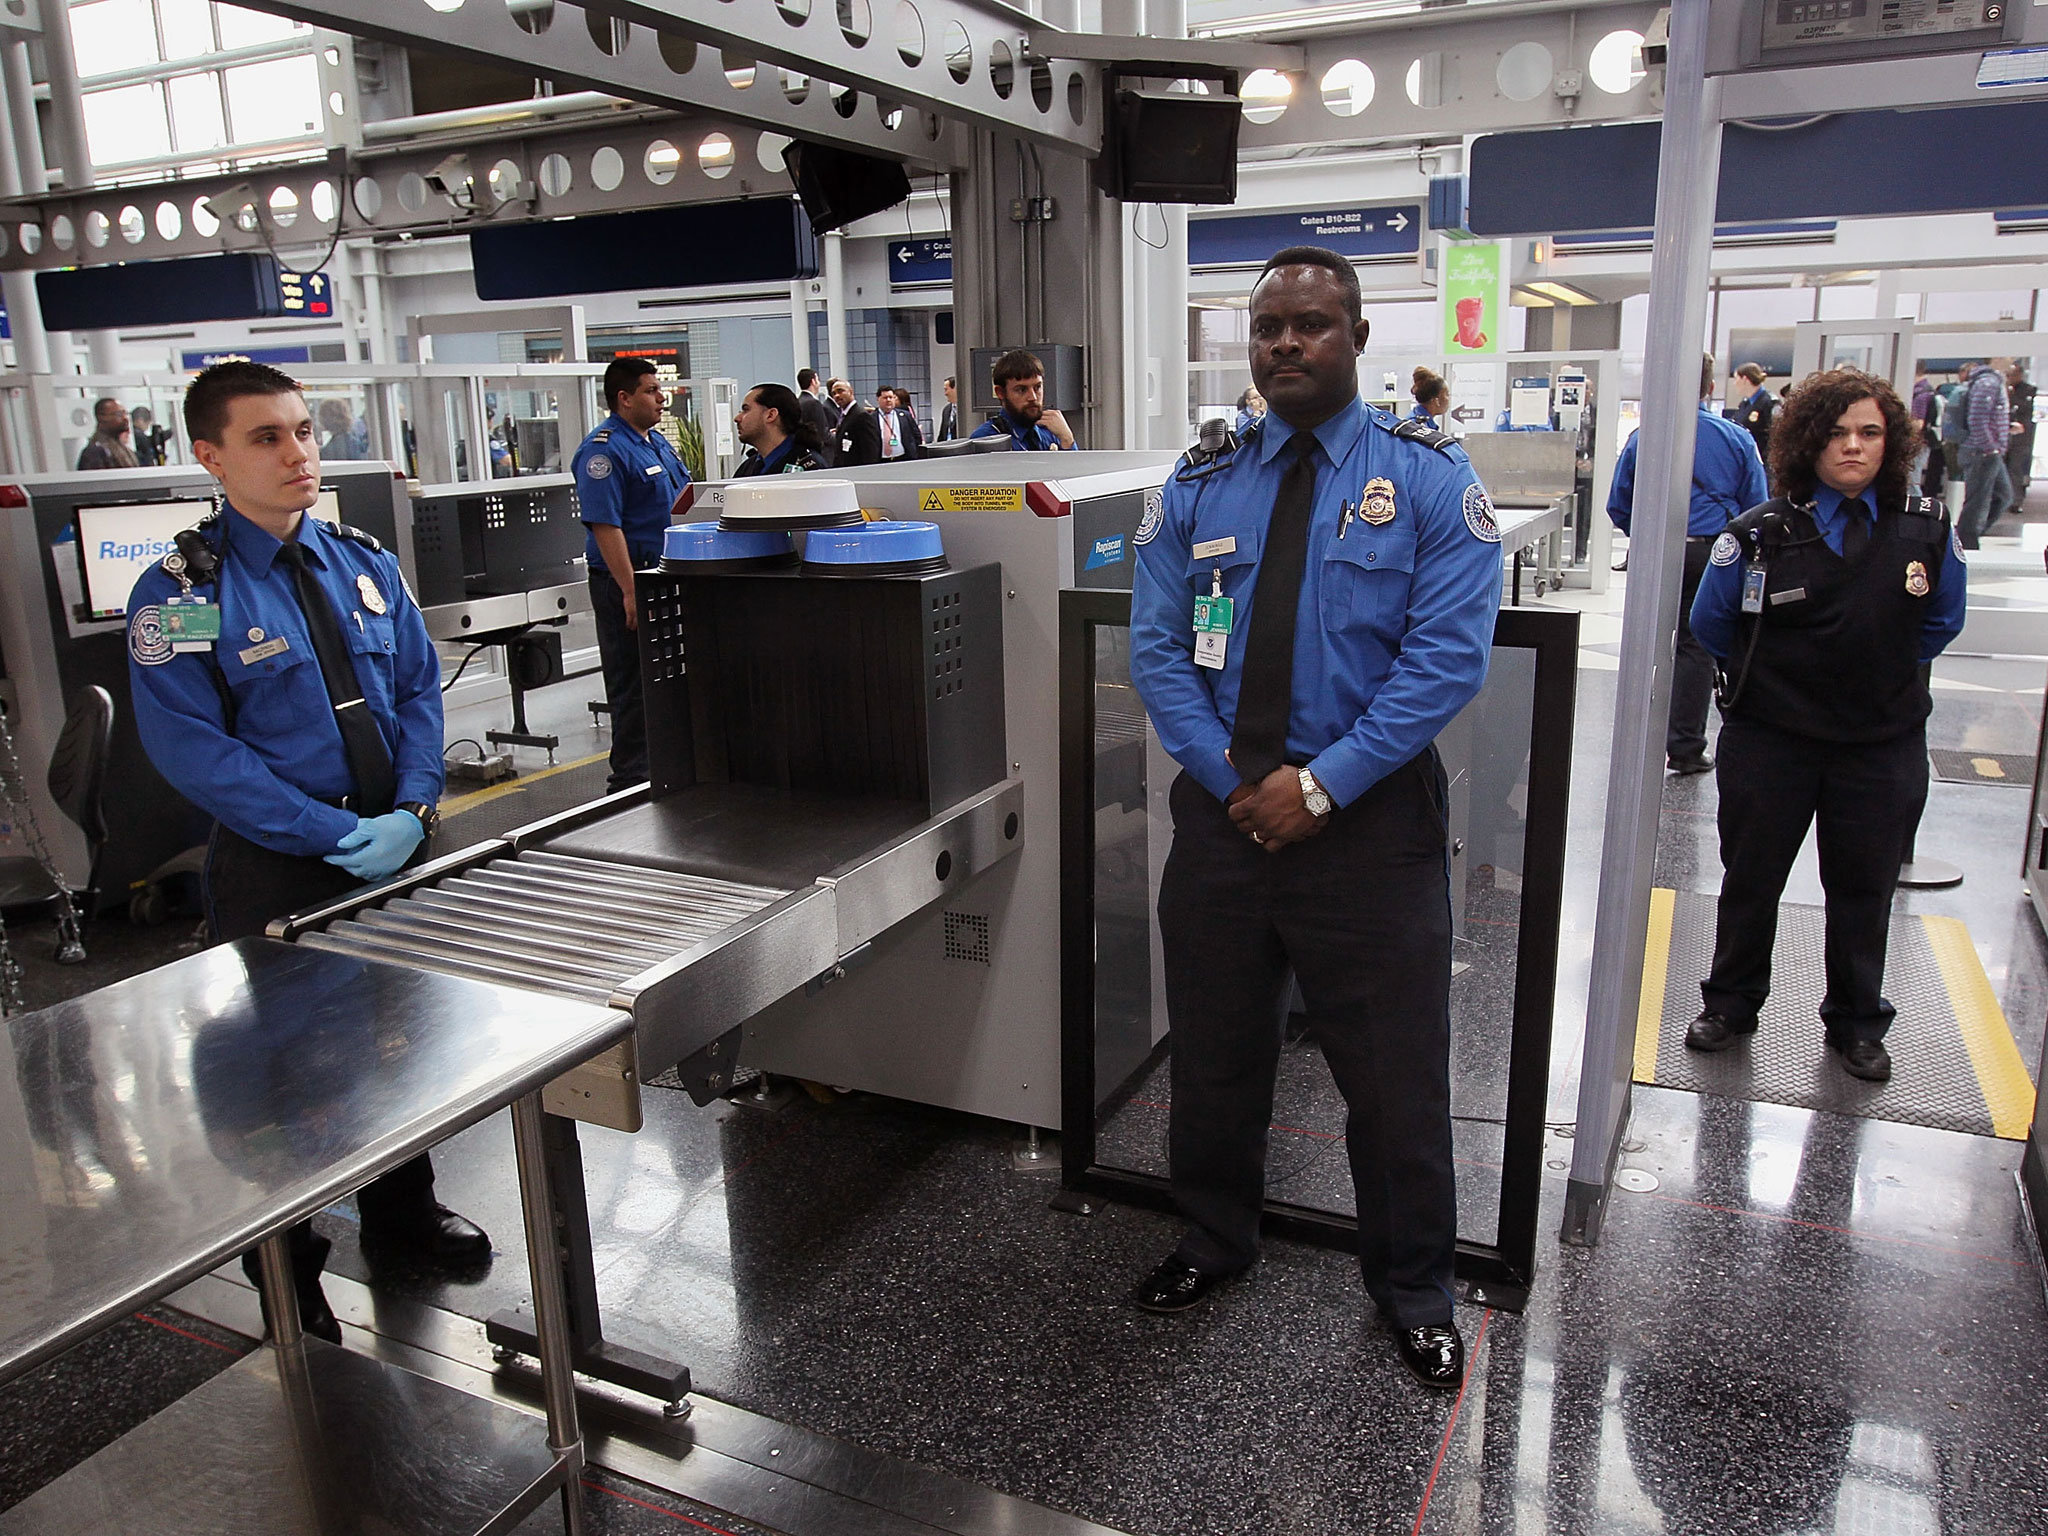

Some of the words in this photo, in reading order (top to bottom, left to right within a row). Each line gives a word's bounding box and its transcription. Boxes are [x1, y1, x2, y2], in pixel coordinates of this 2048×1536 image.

[1300, 216, 1325, 225] Gates
[1326, 213, 1361, 224] B10-B22
[1316, 225, 1361, 235] Restrooms
[1412, 422, 1437, 438] TSA
[949, 489, 979, 497] DANGER
[980, 488, 1017, 496] RADIATION
[1919, 496, 1932, 512] TSA
[1095, 539, 1121, 554] Rapiscan
